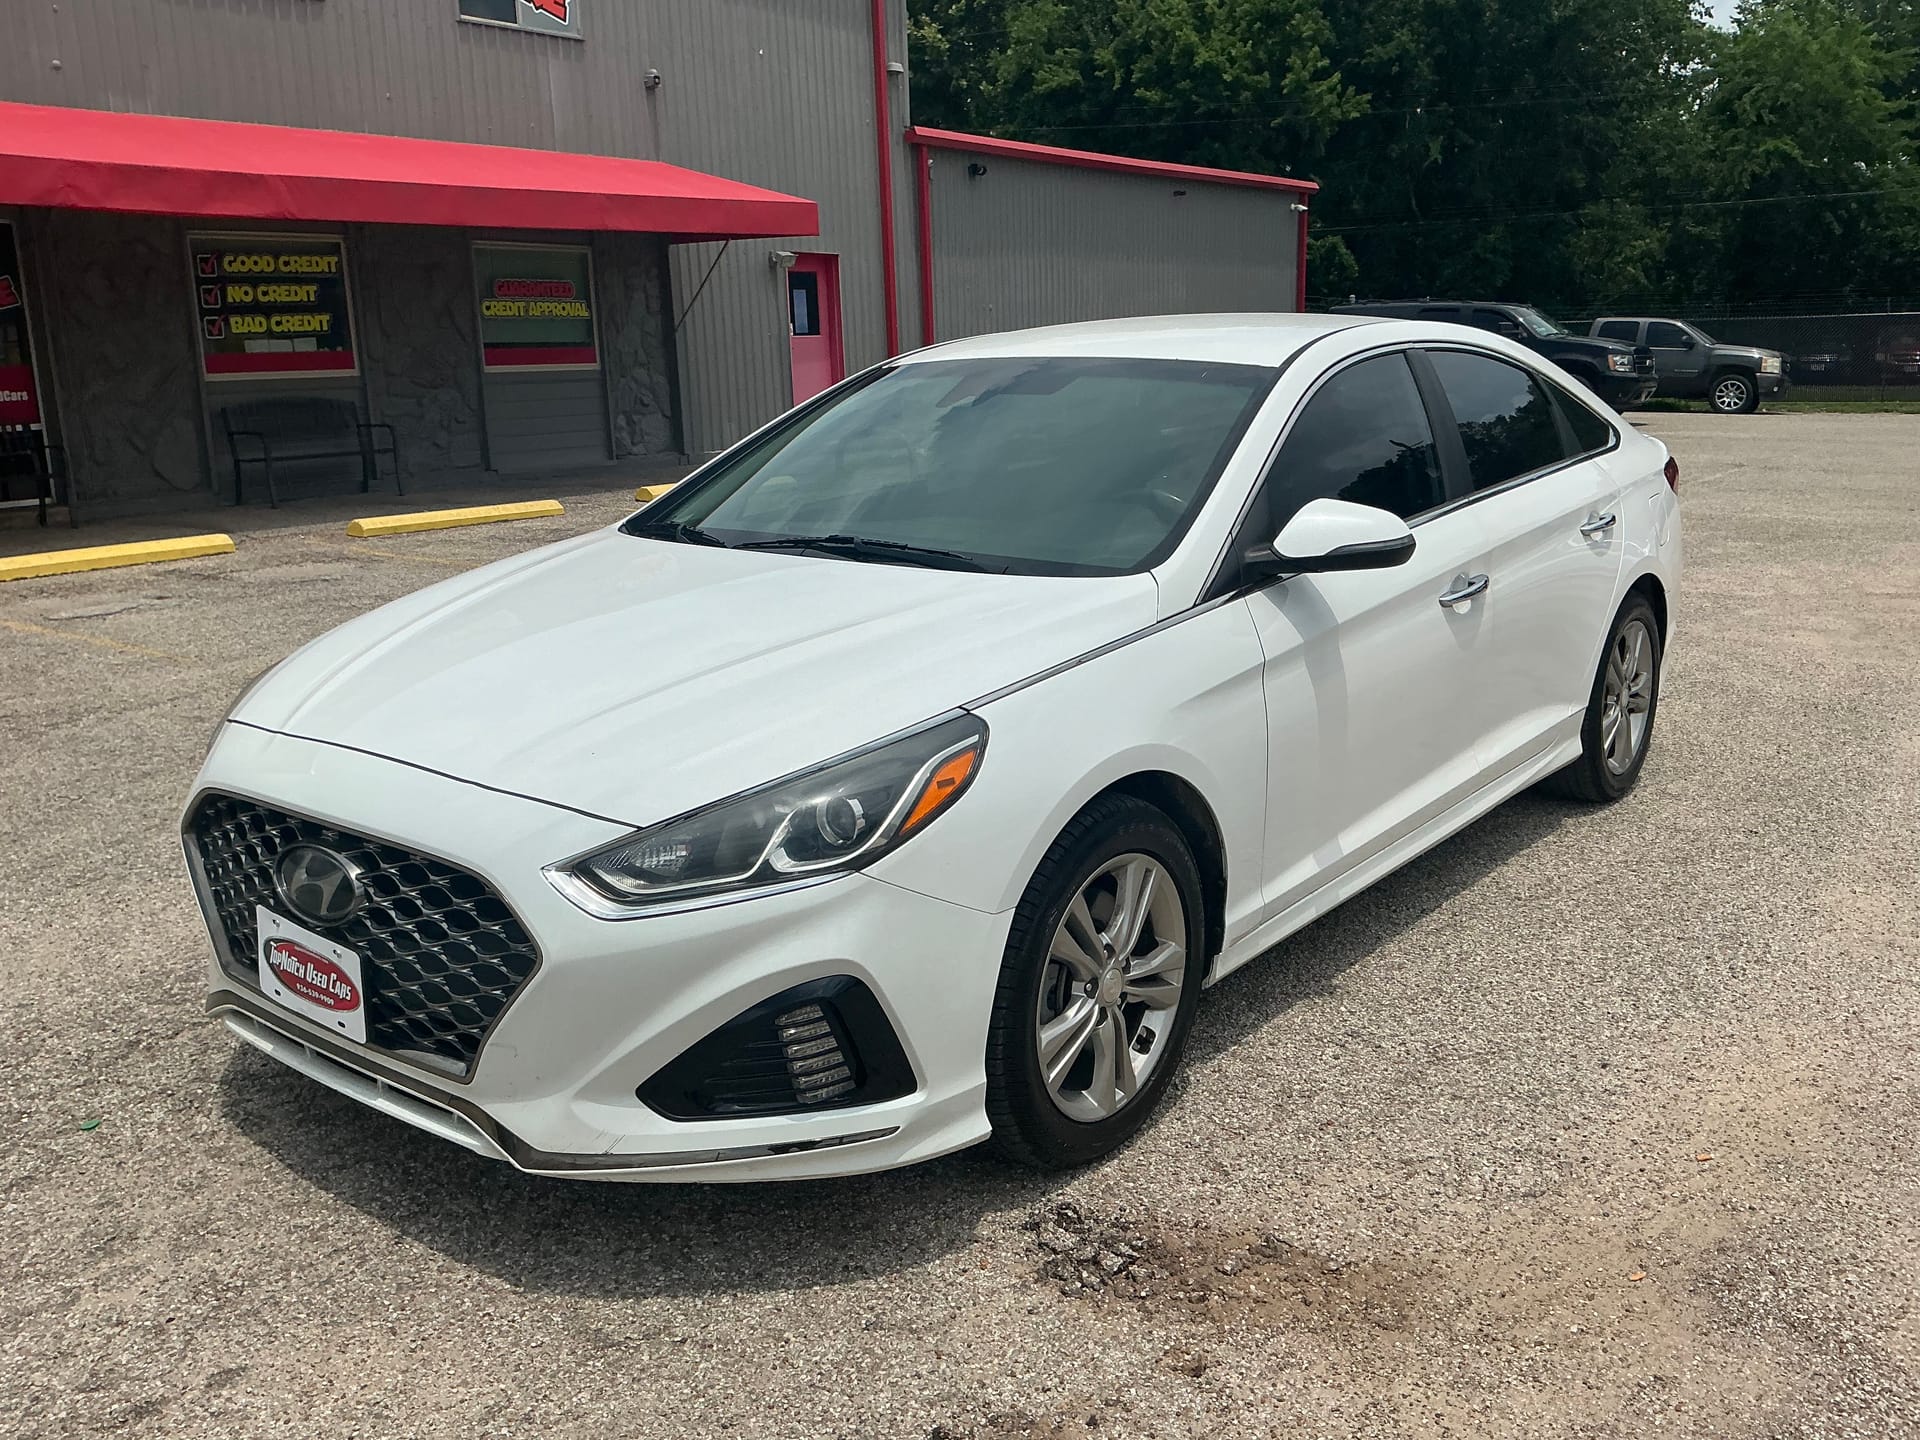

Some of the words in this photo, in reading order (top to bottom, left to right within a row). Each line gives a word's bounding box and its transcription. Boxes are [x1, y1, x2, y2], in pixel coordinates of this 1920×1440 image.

[223, 255, 275, 273] GOOD
[278, 256, 338, 273] CREDIT
[227, 285, 254, 303] NO
[257, 285, 317, 302] CREDIT
[482, 301, 526, 316] CREDIT
[528, 302, 589, 317] APPROVAL
[231, 315, 268, 333] BAD
[270, 315, 330, 332] CREDIT
[306, 962, 328, 989] USED
[329, 972, 352, 1001] CARS
